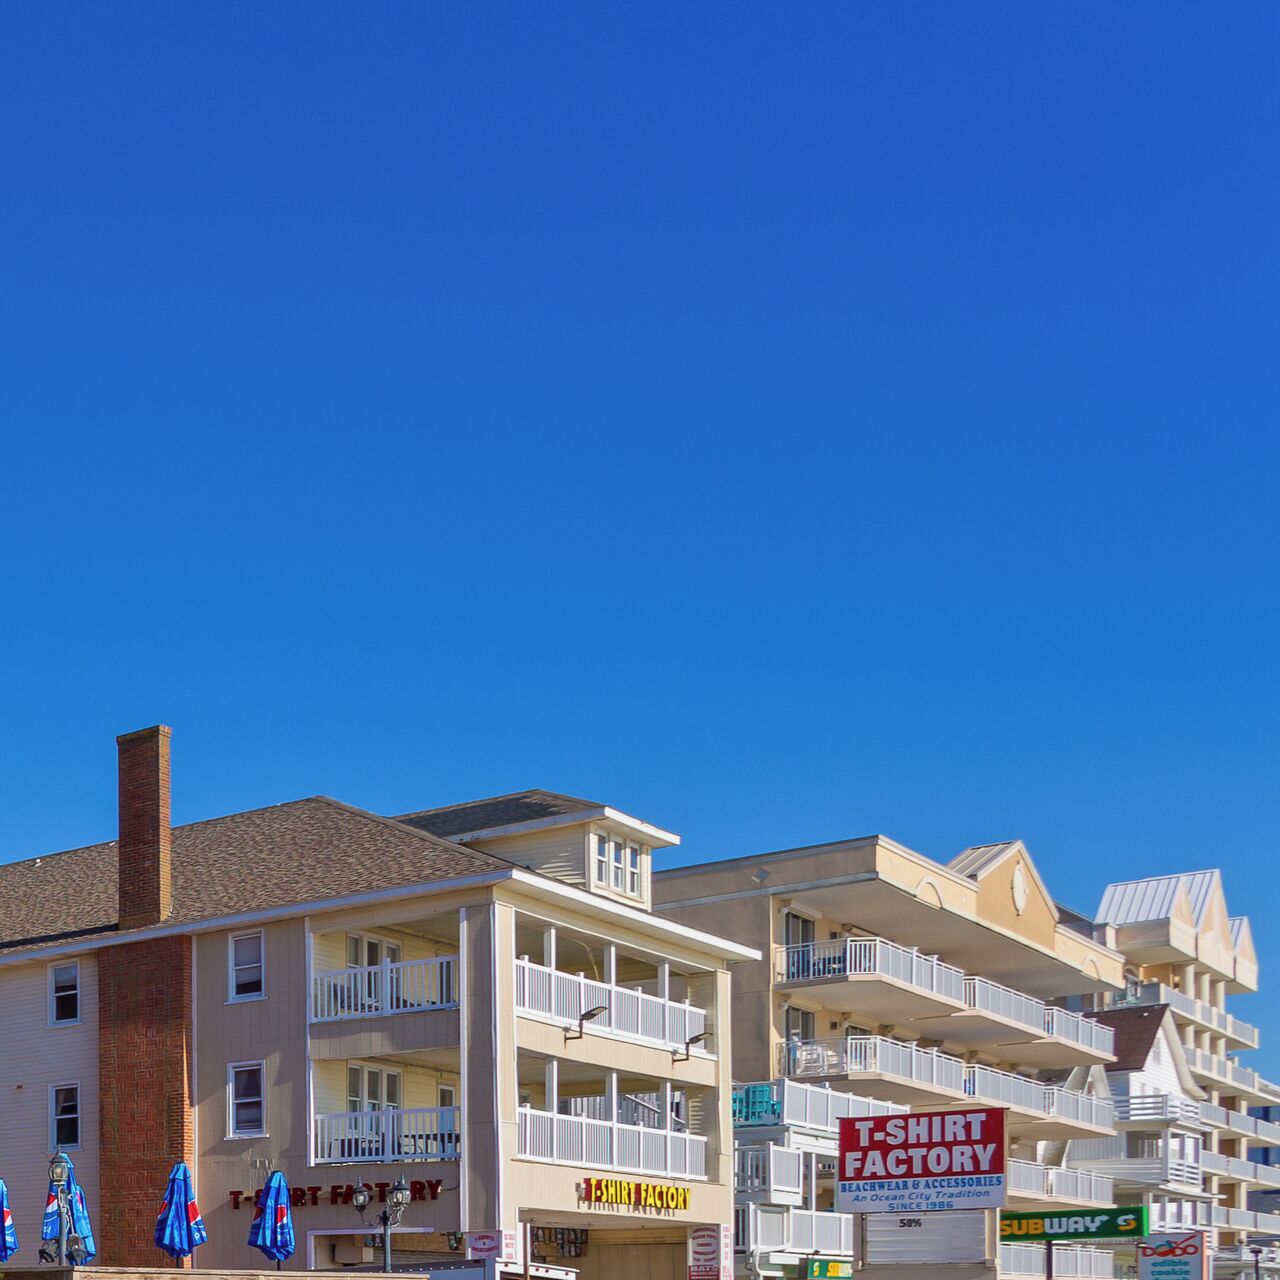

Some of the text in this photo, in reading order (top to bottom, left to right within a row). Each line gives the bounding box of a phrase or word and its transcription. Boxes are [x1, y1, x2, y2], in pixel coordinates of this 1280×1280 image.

[855, 1113, 987, 1147] T-SHIRT
[845, 1143, 996, 1178] FACTORY
[841, 1175, 1002, 1193] BEACHWEAR & ACCESSORIES
[590, 1177, 691, 1210] T-SHIRT FACTORY
[852, 1190, 990, 1203] An Ocean City Tradition
[888, 1201, 954, 1211] SINCE 1986
[899, 1218, 922, 1228] 50%
[1000, 1214, 1109, 1236] SUBWAY
[1151, 1259, 1189, 1267] edible
[1151, 1268, 1191, 1276] cookie
